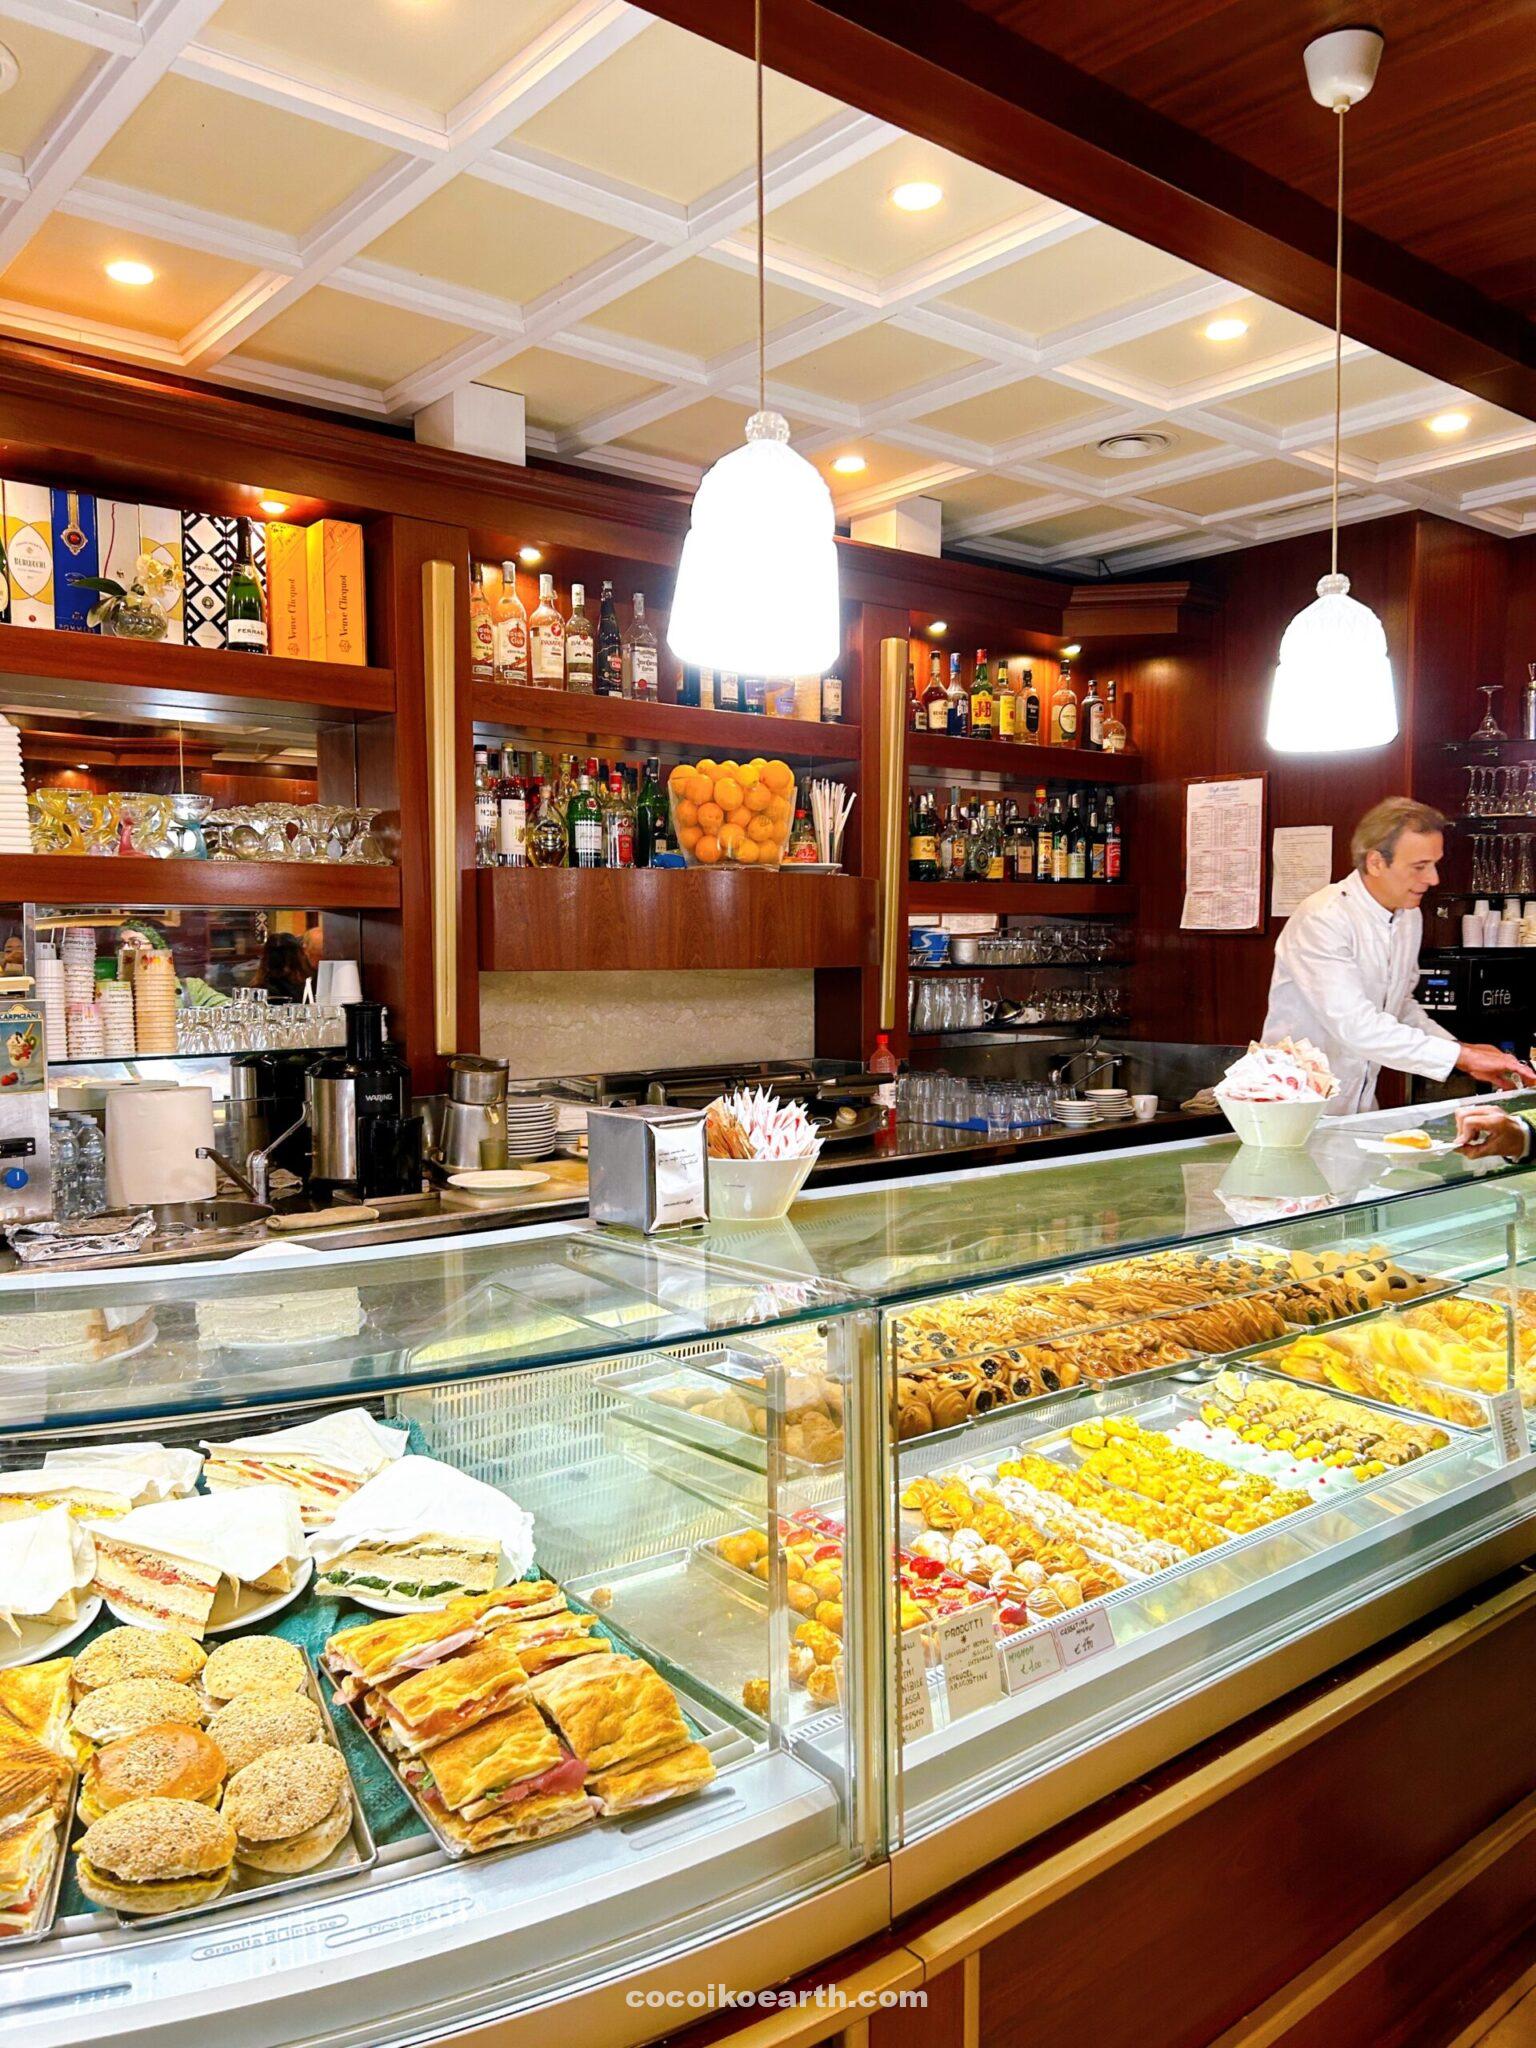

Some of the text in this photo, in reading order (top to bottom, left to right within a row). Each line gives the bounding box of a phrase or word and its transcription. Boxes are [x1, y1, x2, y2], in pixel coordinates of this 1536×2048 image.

[339, 612, 349, 637] Veuve
[365, 1093, 393, 1102] WARING
[944, 1616, 984, 1640] PRODOTTI
